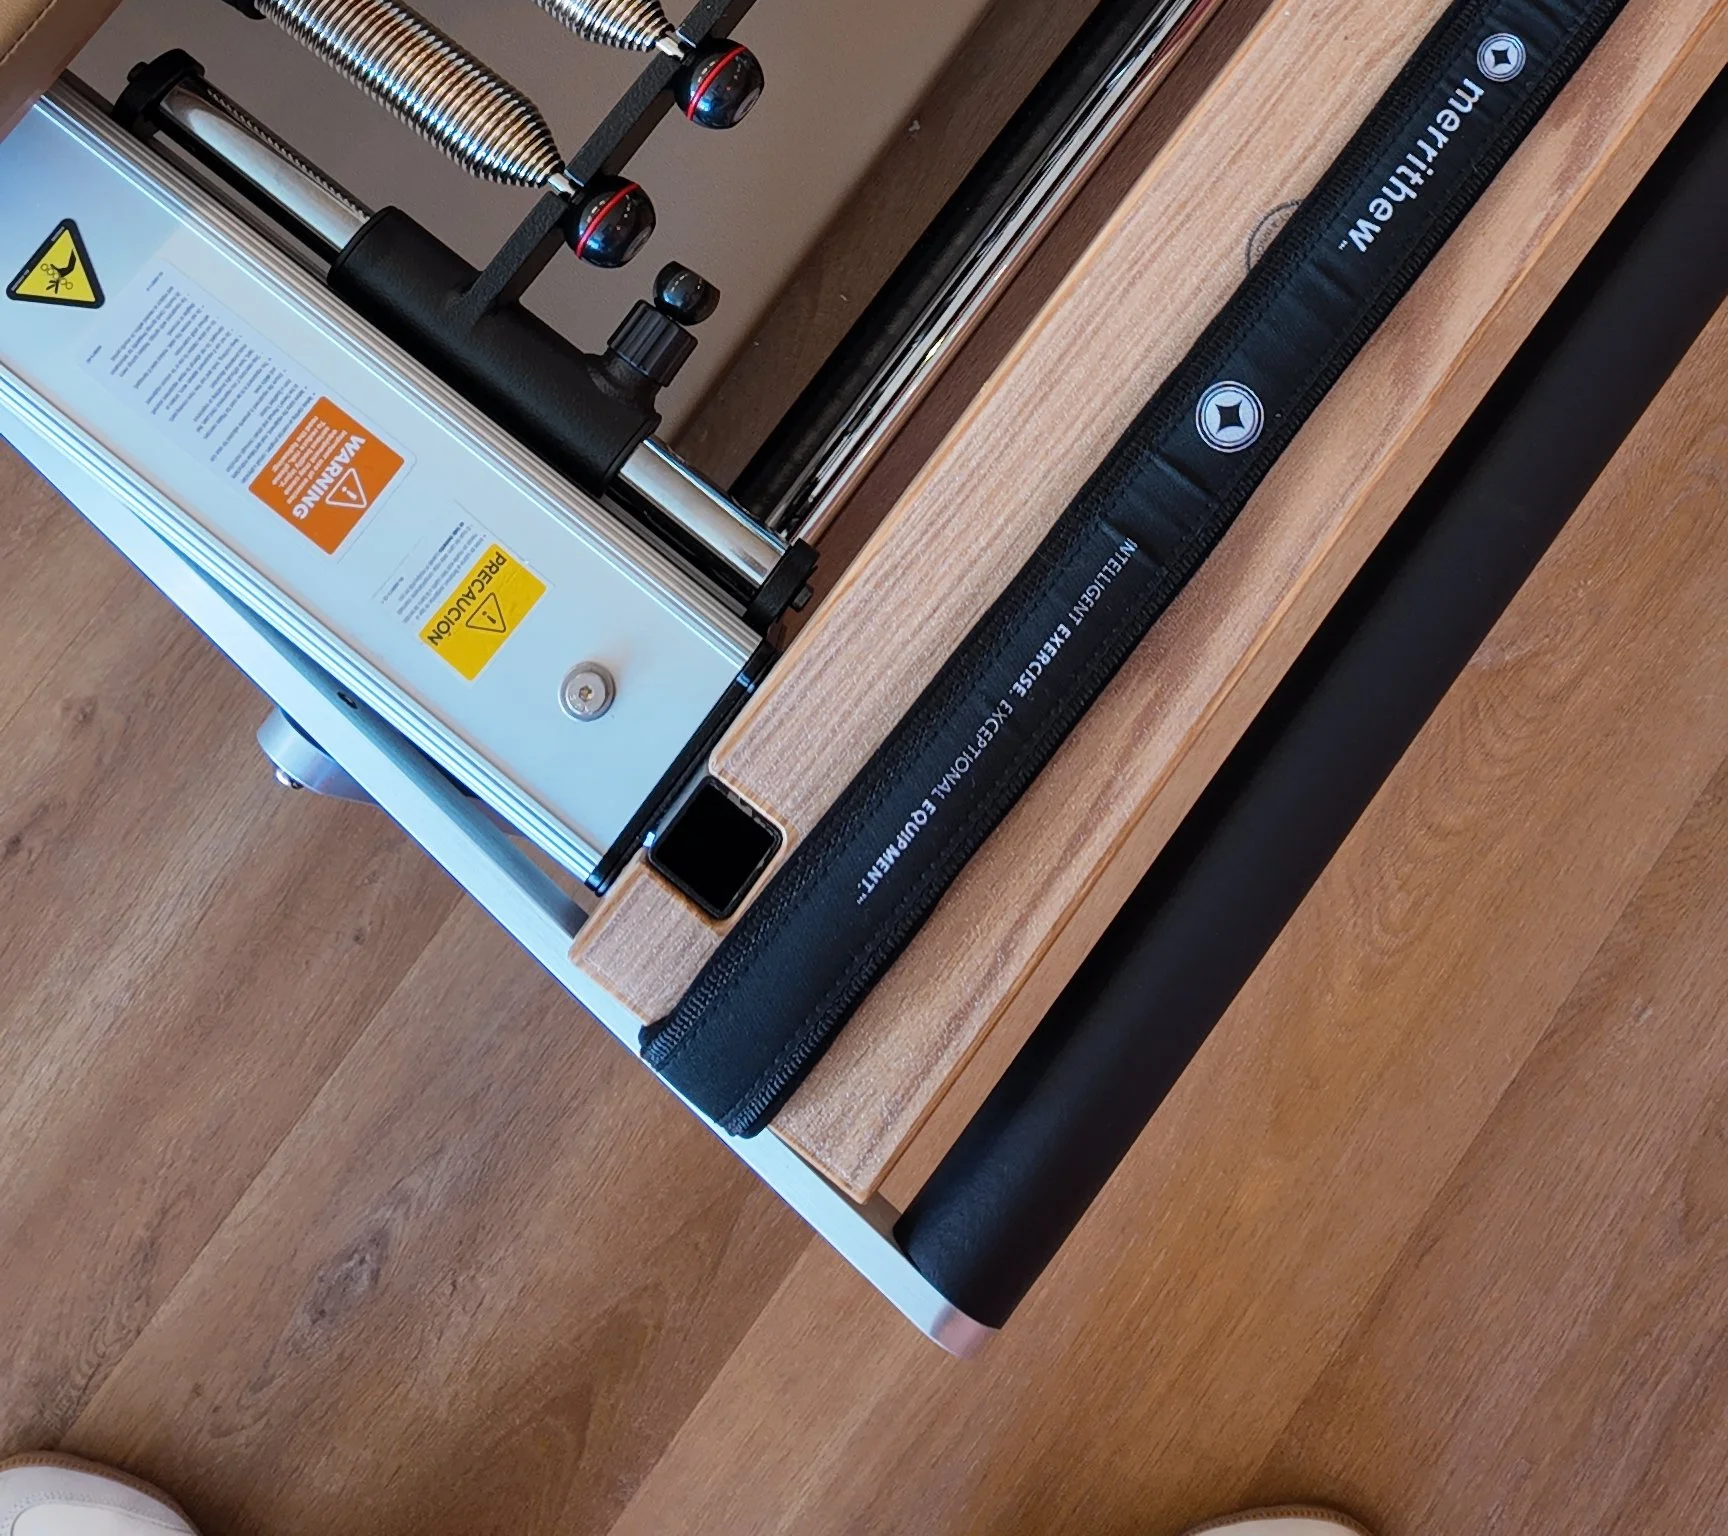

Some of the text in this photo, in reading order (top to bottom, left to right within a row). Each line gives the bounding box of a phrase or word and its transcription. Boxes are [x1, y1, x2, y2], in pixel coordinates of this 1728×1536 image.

[292, 435, 366, 519] WARNING
[426, 551, 508, 646] PRECAUCIÓN
[1068, 537, 1138, 626] INTELLIGENT
[1009, 623, 1072, 698] EXERCISE.
[930, 699, 1014, 800] EXCEPTIONAL
